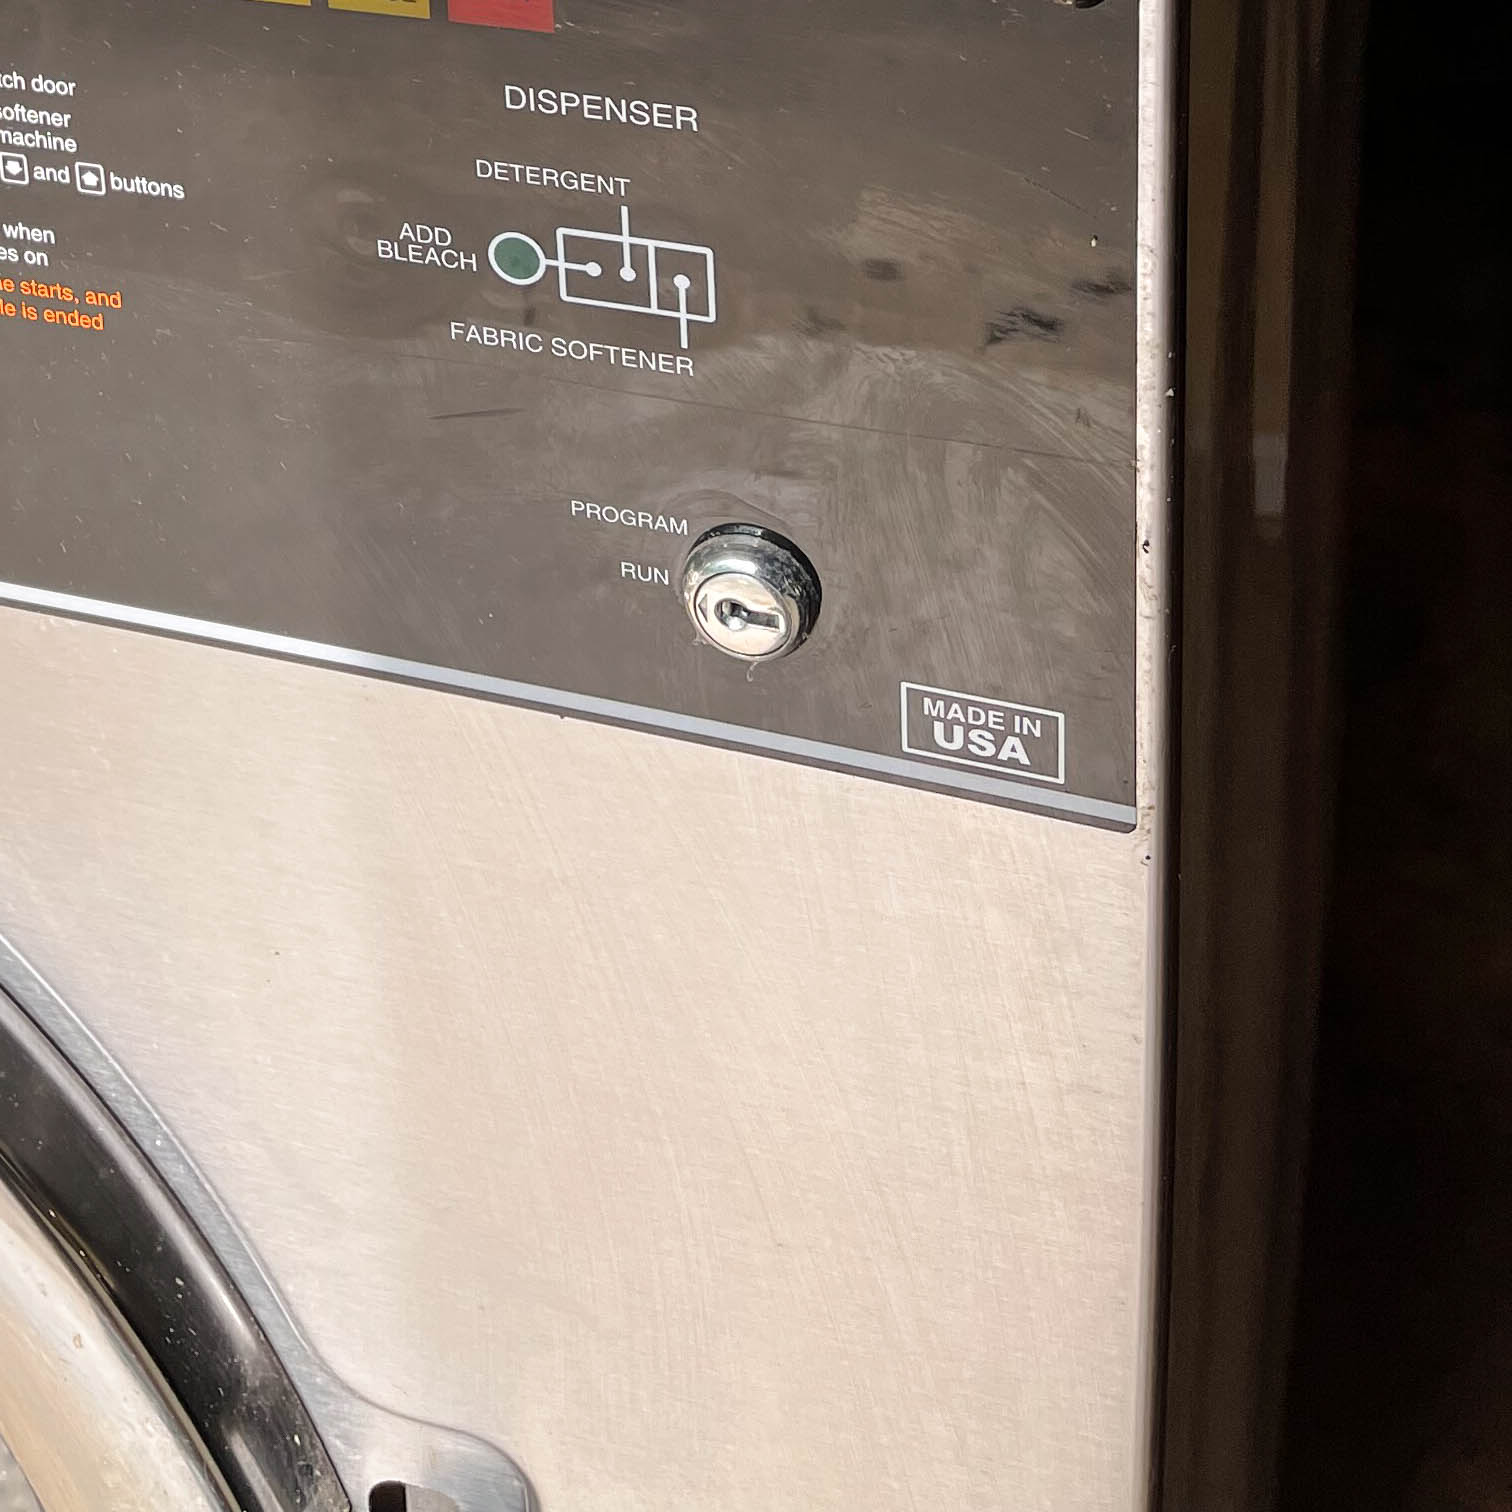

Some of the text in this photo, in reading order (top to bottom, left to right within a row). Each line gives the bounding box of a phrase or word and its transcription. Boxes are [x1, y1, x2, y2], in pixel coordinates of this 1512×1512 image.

[31, 74, 76, 96] door
[505, 85, 698, 132] DISPENSER
[33, 164, 69, 184] and
[110, 172, 185, 199] buttons
[476, 159, 630, 196] DETERGENT
[3, 222, 55, 244] when
[400, 223, 451, 246] ADD
[24, 250, 49, 266] on
[377, 240, 477, 272] BLEACH
[20, 280, 79, 304] starts,
[86, 291, 122, 308] and
[451, 322, 694, 376] FABRIC SOFTENER
[571, 500, 688, 535] PROGRAM
[620, 562, 669, 585] RUN
[923, 698, 1041, 737] MADE IN
[933, 722, 1030, 766] USA
